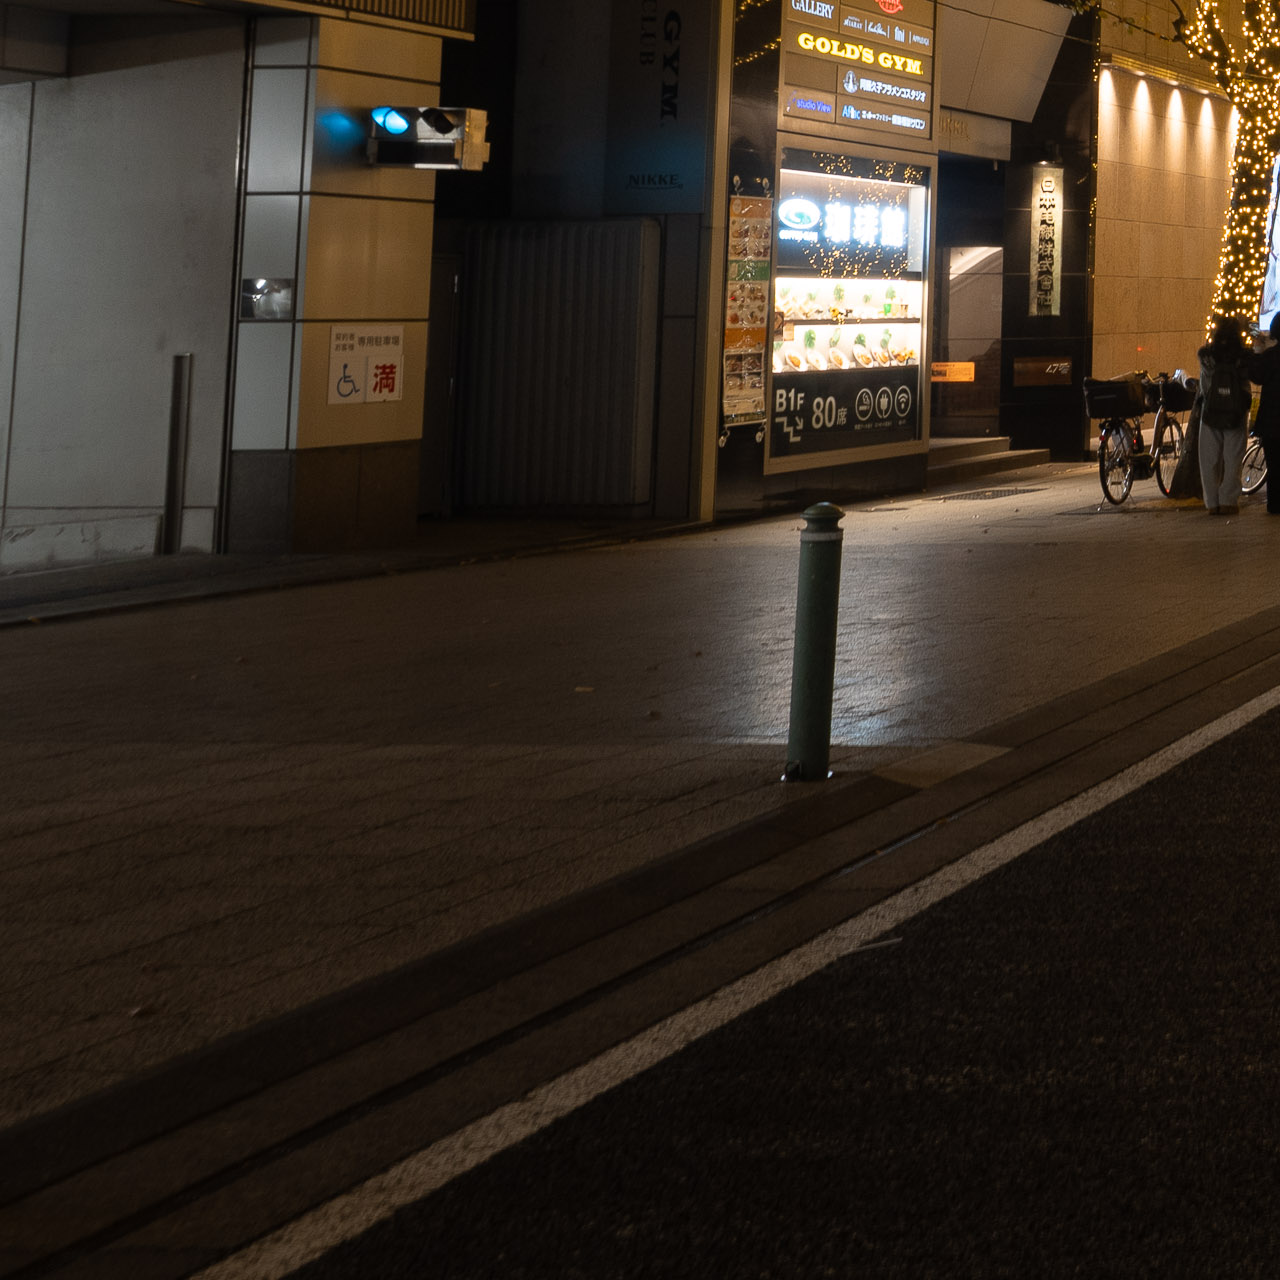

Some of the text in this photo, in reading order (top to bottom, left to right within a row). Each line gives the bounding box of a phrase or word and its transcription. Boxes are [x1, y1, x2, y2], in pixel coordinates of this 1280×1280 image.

[659, 10, 684, 122] GYM
[797, 32, 924, 76] GOLD'S GYM
[796, 97, 833, 115] studio View
[627, 172, 680, 187] NIKKE
[372, 363, 397, 394] 満
[775, 387, 806, 413] B1F
